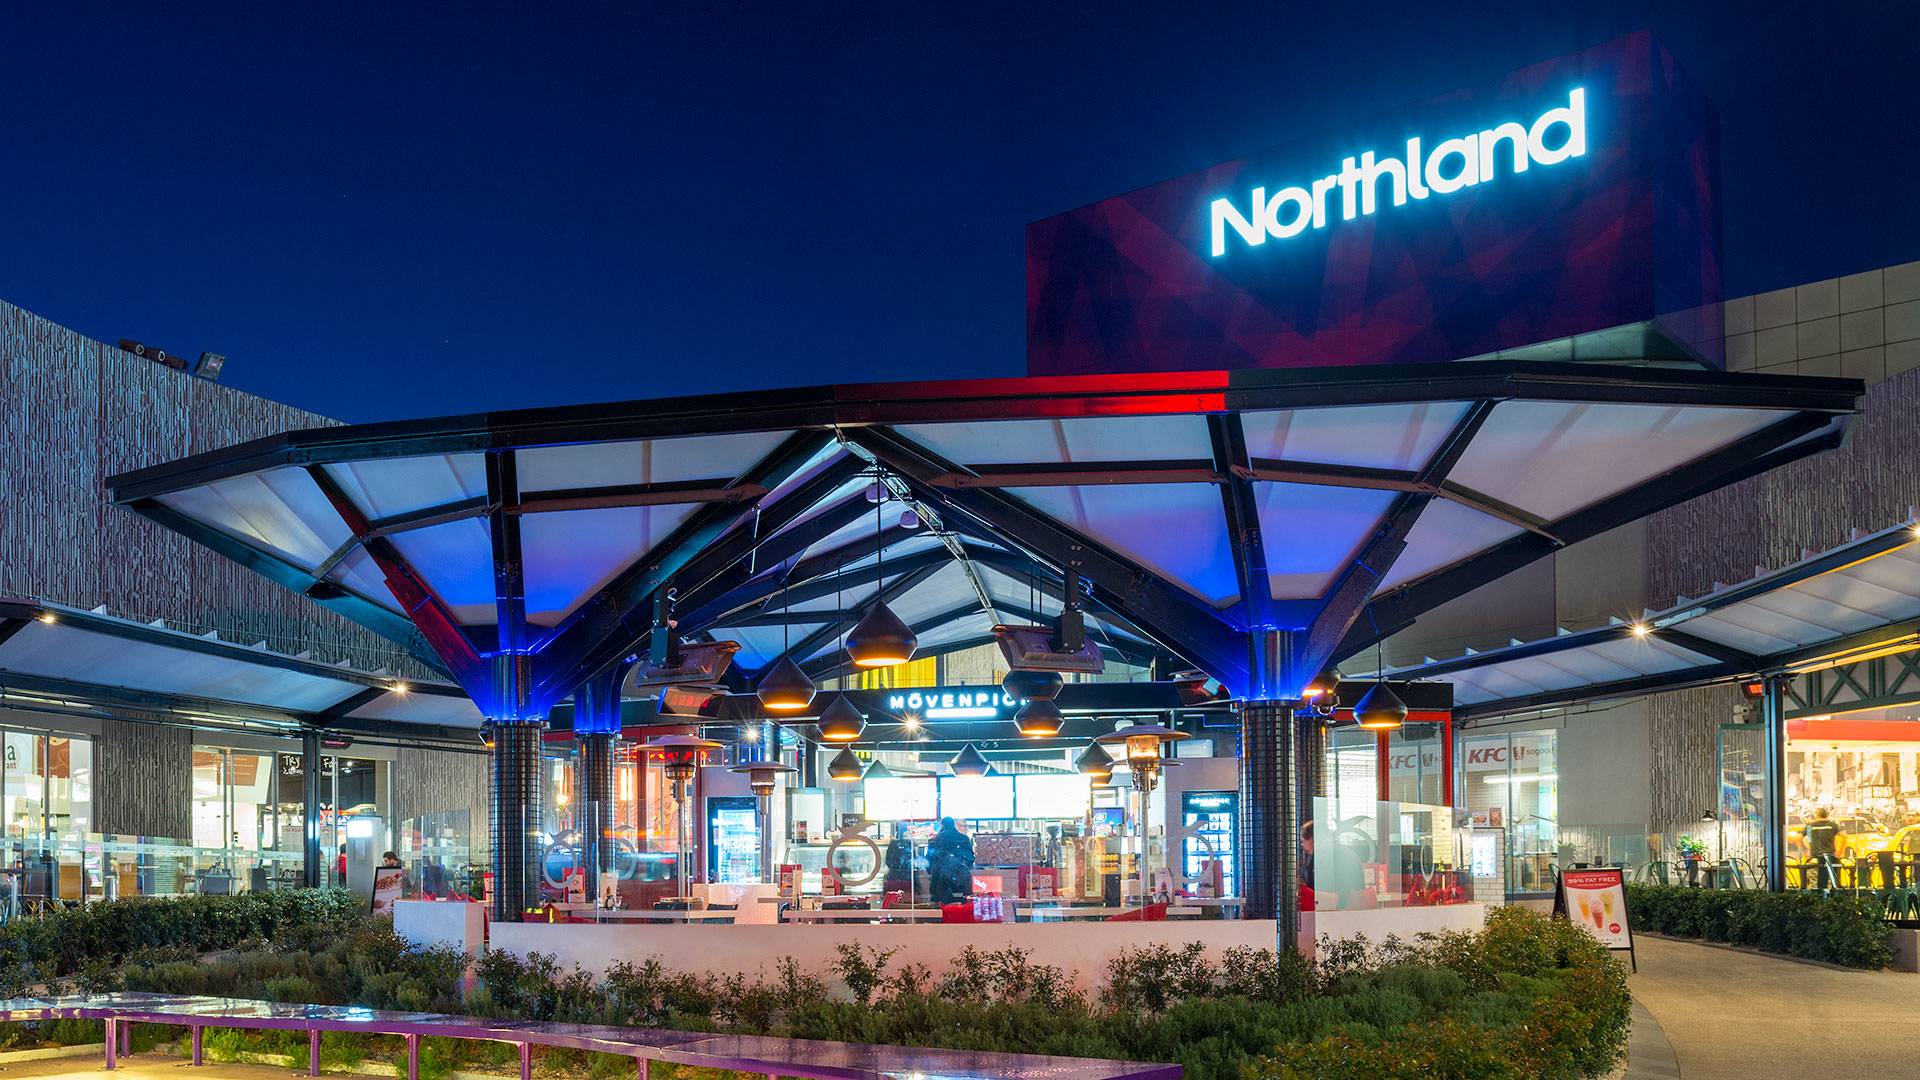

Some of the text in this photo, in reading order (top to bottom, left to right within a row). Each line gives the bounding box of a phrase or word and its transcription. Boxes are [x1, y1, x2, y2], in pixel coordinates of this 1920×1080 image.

[1211, 87, 1586, 257] Northland
[890, 692, 1029, 709] MÖVENPIC
[1468, 747, 1507, 764] KFC
